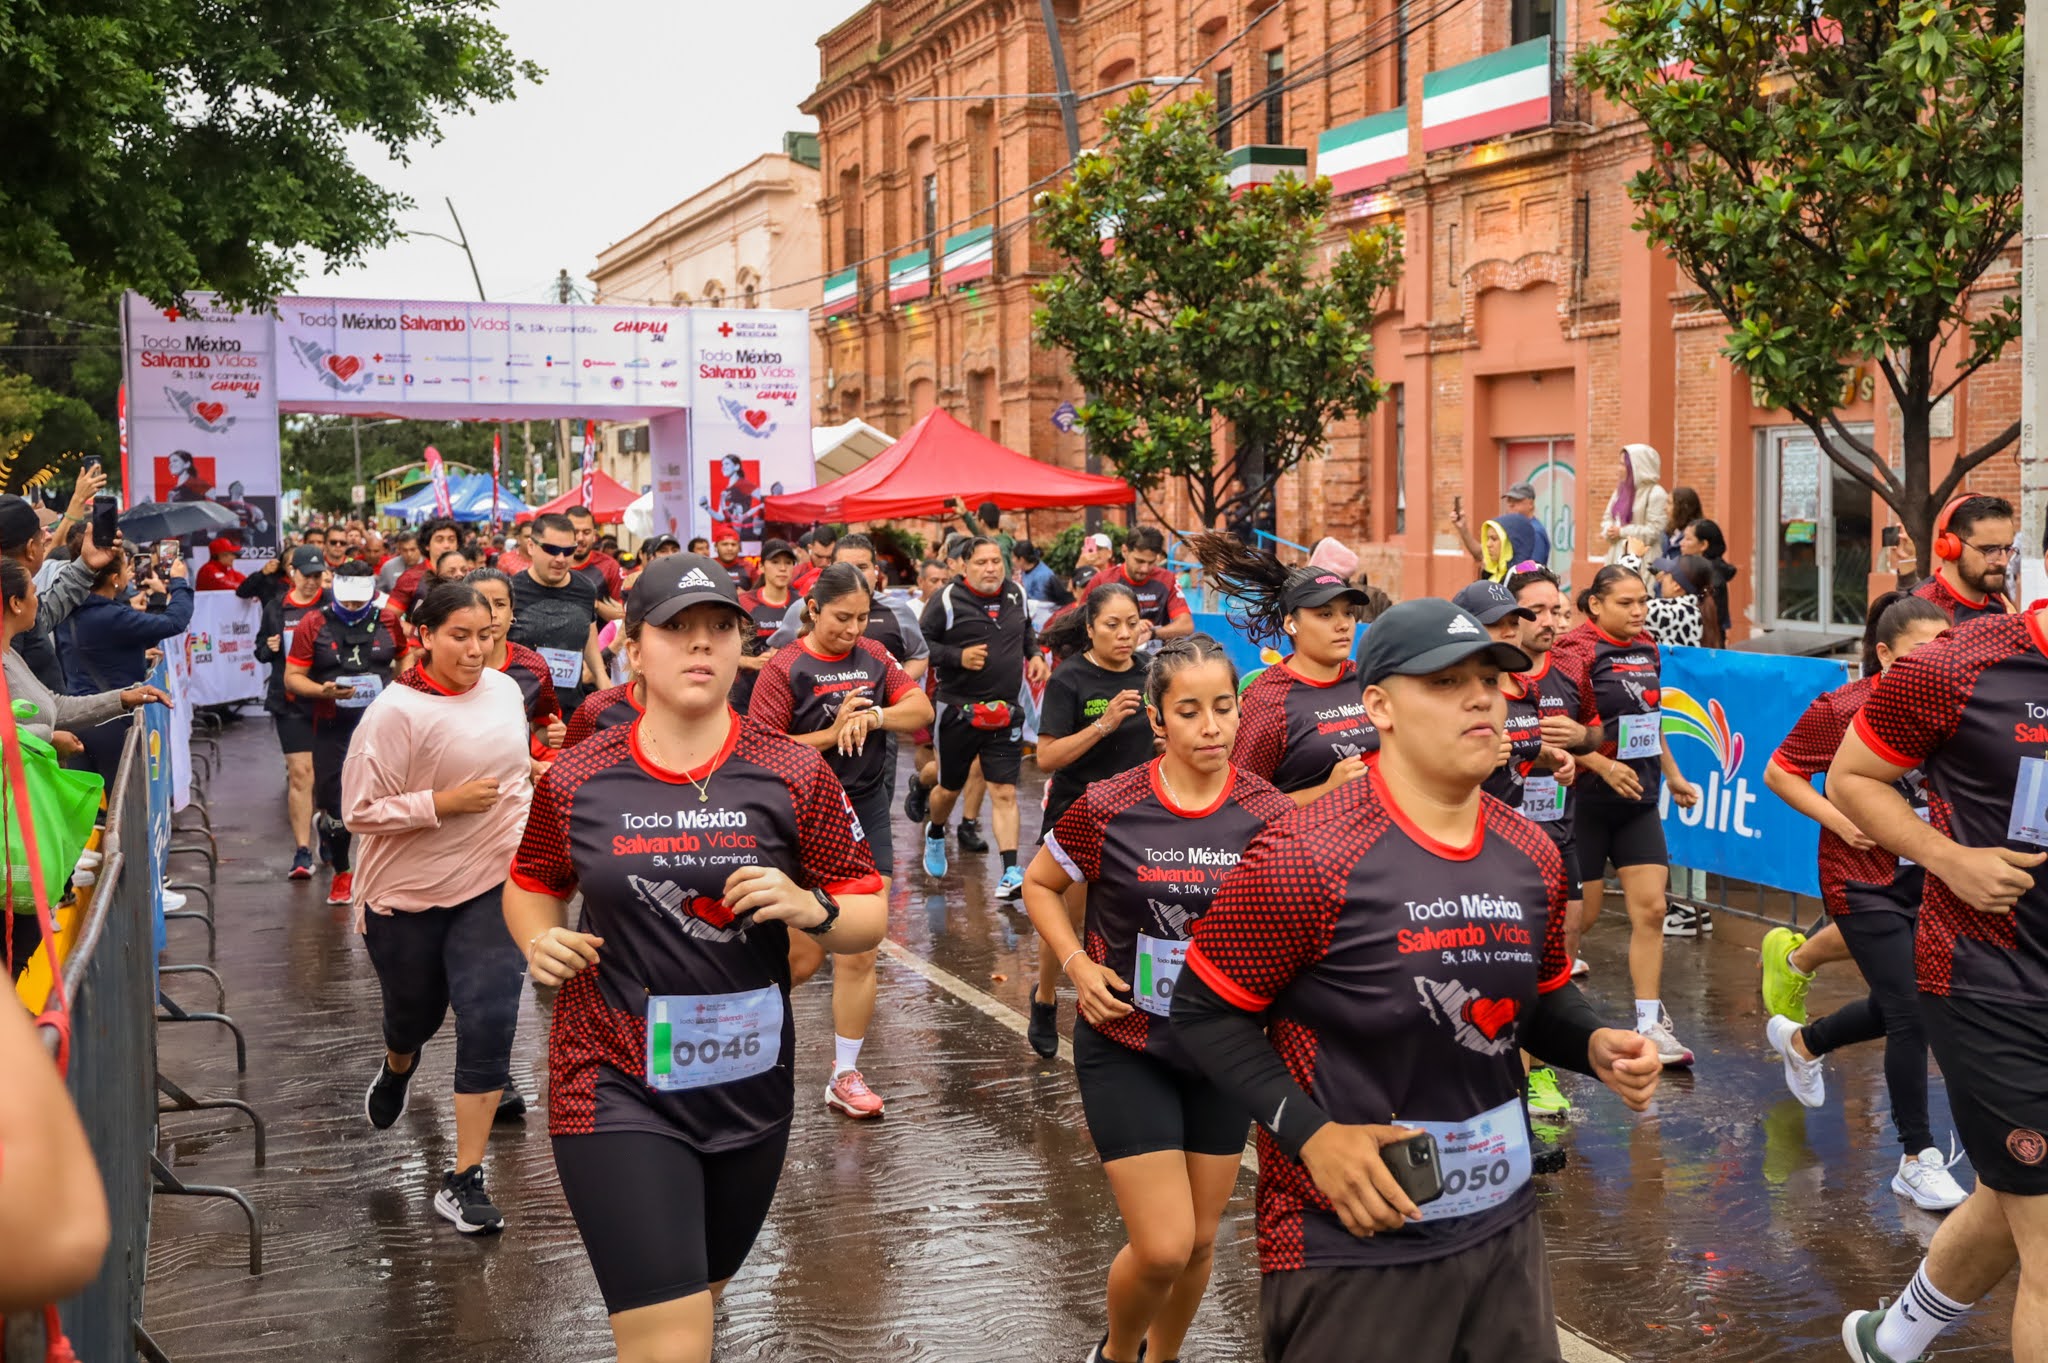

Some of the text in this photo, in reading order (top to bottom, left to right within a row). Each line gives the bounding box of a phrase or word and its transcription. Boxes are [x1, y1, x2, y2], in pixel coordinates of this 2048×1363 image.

[299, 312, 337, 327] Todo
[342, 313, 396, 330] México
[400, 314, 465, 331] Salvando
[470, 317, 509, 331] Vidas
[613, 321, 668, 334] CHAPALA
[142, 335, 241, 352] Todo México
[141, 350, 257, 368] Salvando Vidas
[700, 349, 782, 364] Todo México
[700, 364, 796, 379] Salvando Vidas
[211, 382, 260, 391] CHAPALA
[756, 391, 797, 400] CHAPALA
[242, 546, 276, 558] 2025
[678, 579, 716, 589] adidas
[1136, 592, 1157, 601] éxico
[814, 670, 868, 683] Todo México
[353, 690, 377, 700] 448
[813, 681, 852, 697] Salvando
[1086, 698, 1109, 708] PURO
[1539, 695, 1564, 707] éxico
[1314, 703, 1366, 720] Todo Méxic
[2025, 703, 2048, 719] To
[1317, 717, 1359, 735] Salvando
[622, 807, 747, 829] Todo México
[612, 831, 757, 856] Salvando Vidas
[653, 852, 758, 868] 5k, 10k y caminata
[1145, 847, 1241, 865] Todo México
[1137, 865, 1206, 882] Salvando
[1168, 883, 1182, 895] 5k,
[1184, 883, 1201, 894] 10k
[1202, 887, 1210, 896] y
[1404, 893, 1522, 921] Todo México
[1397, 922, 1531, 954] Salvando Vidas
[1441, 951, 1458, 965] 5k,
[1460, 949, 1481, 962] 10k
[1483, 951, 1490, 963] y
[673, 1031, 760, 1067] 0046
[1443, 1158, 1510, 1195] 050
